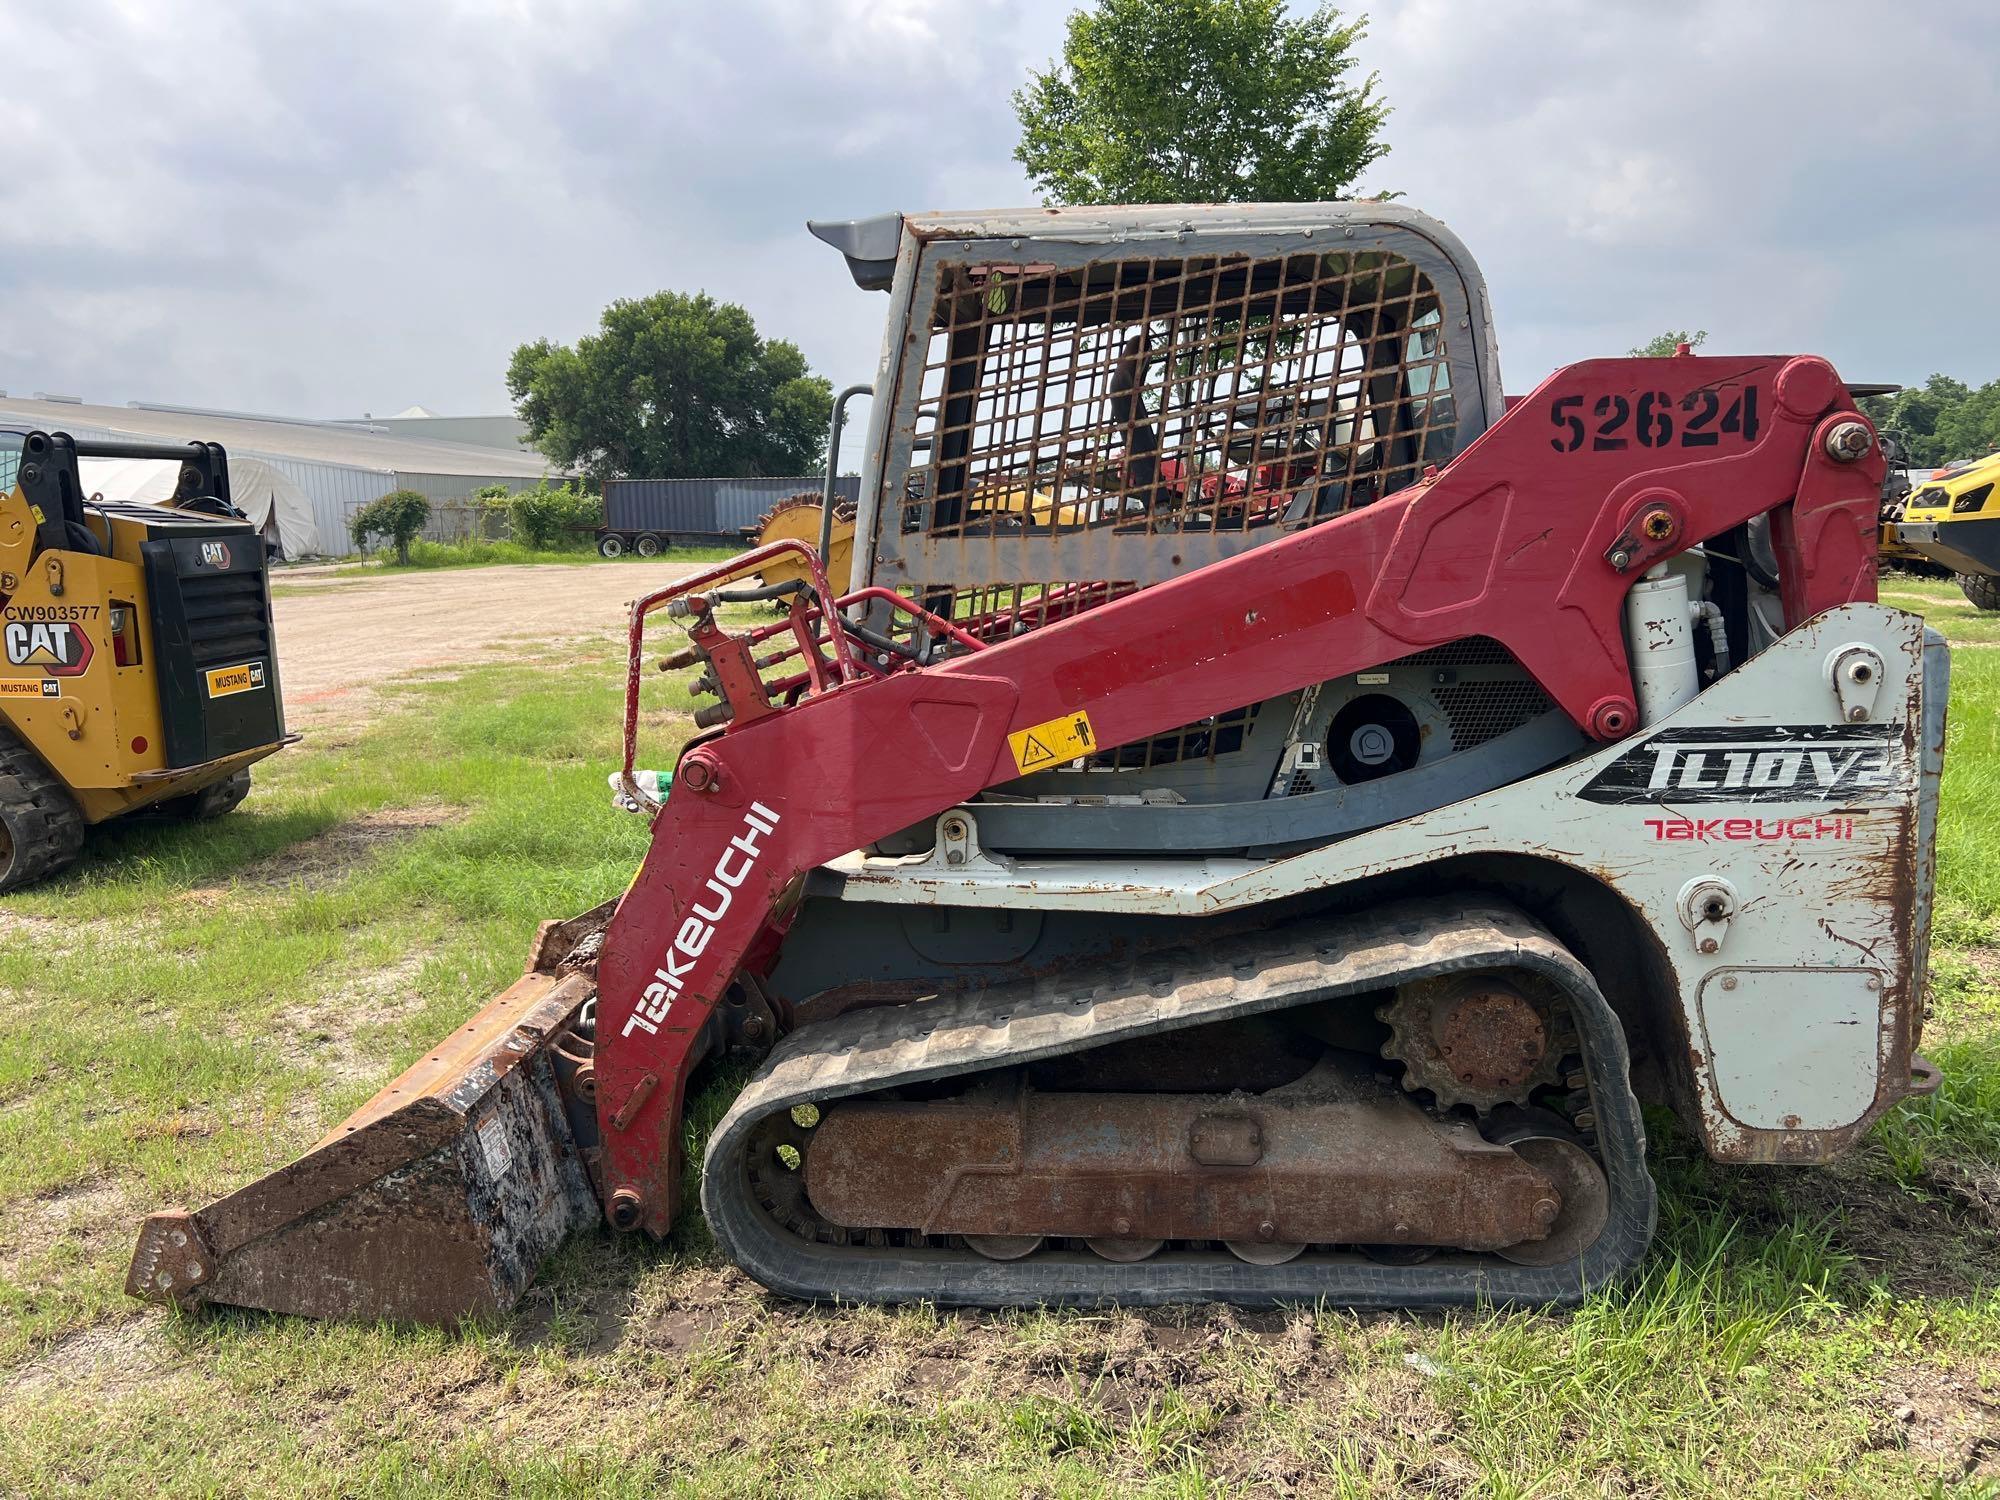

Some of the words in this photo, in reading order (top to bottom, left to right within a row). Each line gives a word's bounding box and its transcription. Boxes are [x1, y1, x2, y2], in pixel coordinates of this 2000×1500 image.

[1551, 385, 1760, 453] 52624
[201, 542, 224, 563] CAT
[4, 606, 100, 620] CW903577
[6, 623, 70, 664] CAT
[0, 684, 39, 693] MUSTANG
[43, 683, 57, 693] CAT
[215, 673, 248, 688] MUSTANG
[250, 669, 262, 682] CAT
[1644, 741, 1901, 789] TL10V2
